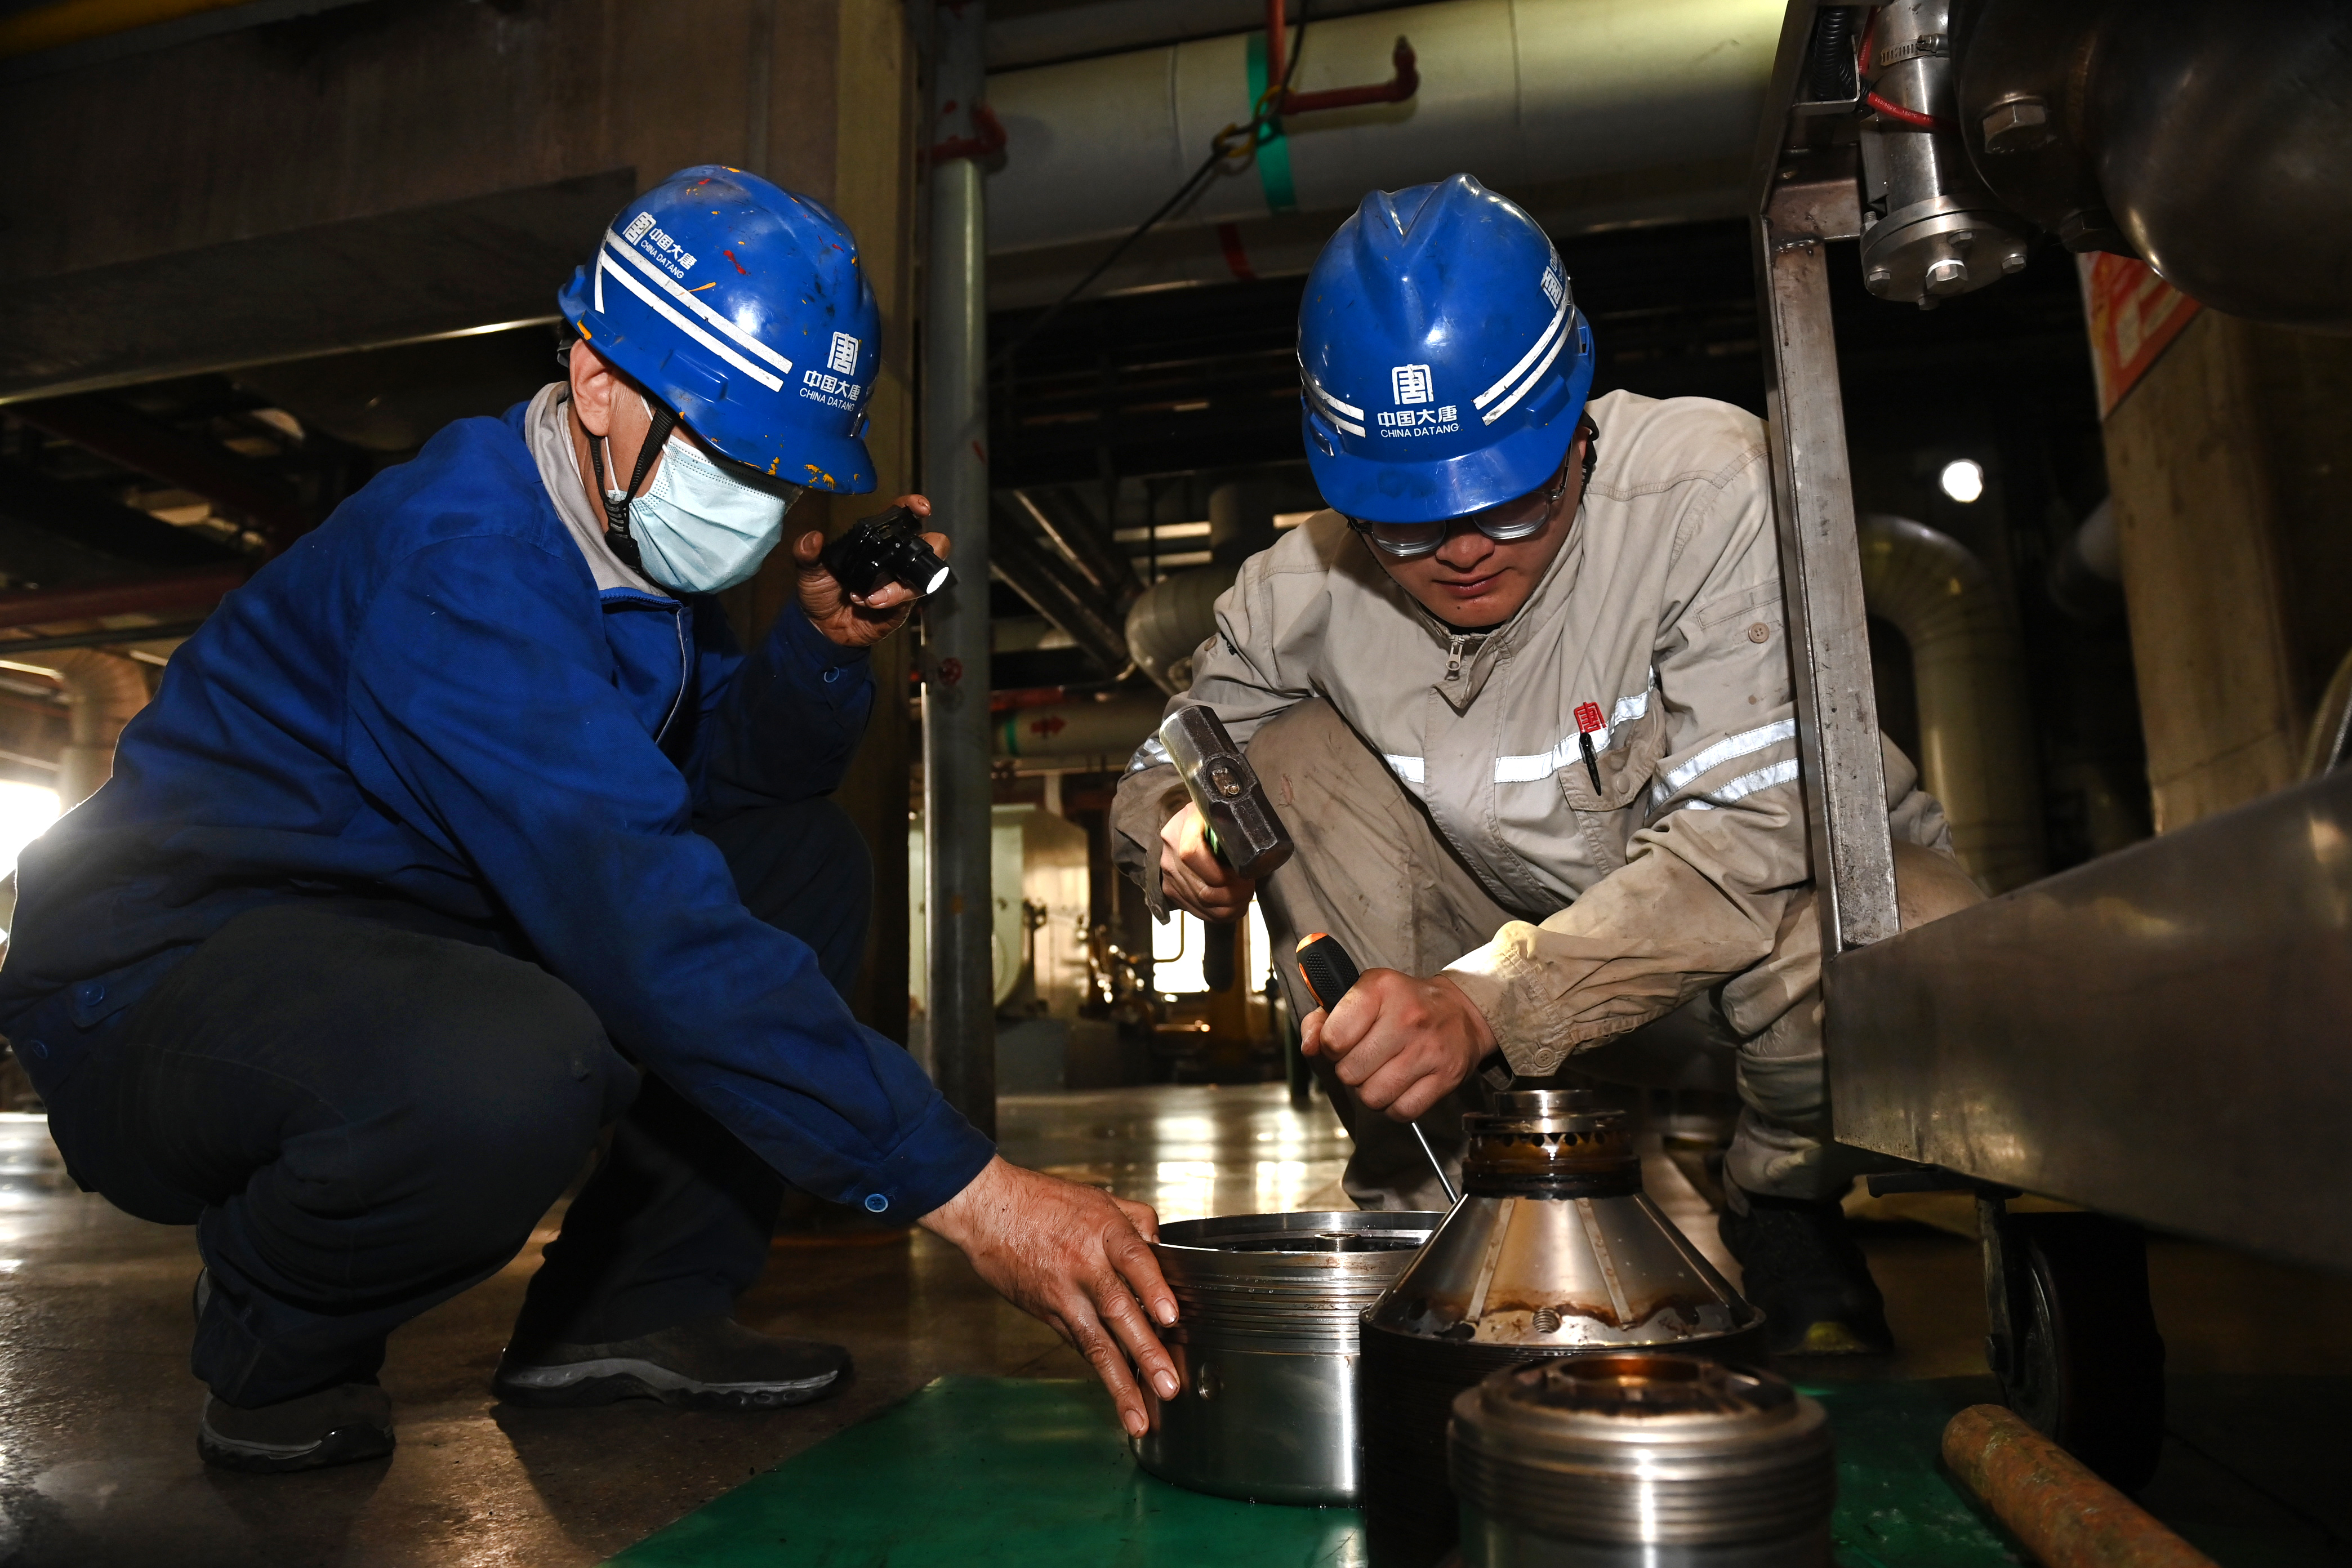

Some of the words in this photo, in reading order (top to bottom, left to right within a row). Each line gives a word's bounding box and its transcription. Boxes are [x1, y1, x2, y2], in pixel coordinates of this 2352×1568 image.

[640, 239, 658, 258] CHINA
[656, 253, 685, 279] DATANG
[648, 228, 697, 270] 中国大唐
[799, 387, 826, 404] CHINA
[827, 396, 855, 412] DATANG
[803, 370, 862, 402] 中国大唐
[1377, 404, 1458, 427] 中国大唐
[1380, 429, 1412, 438] CHINA
[1414, 423, 1459, 437] DATANG
